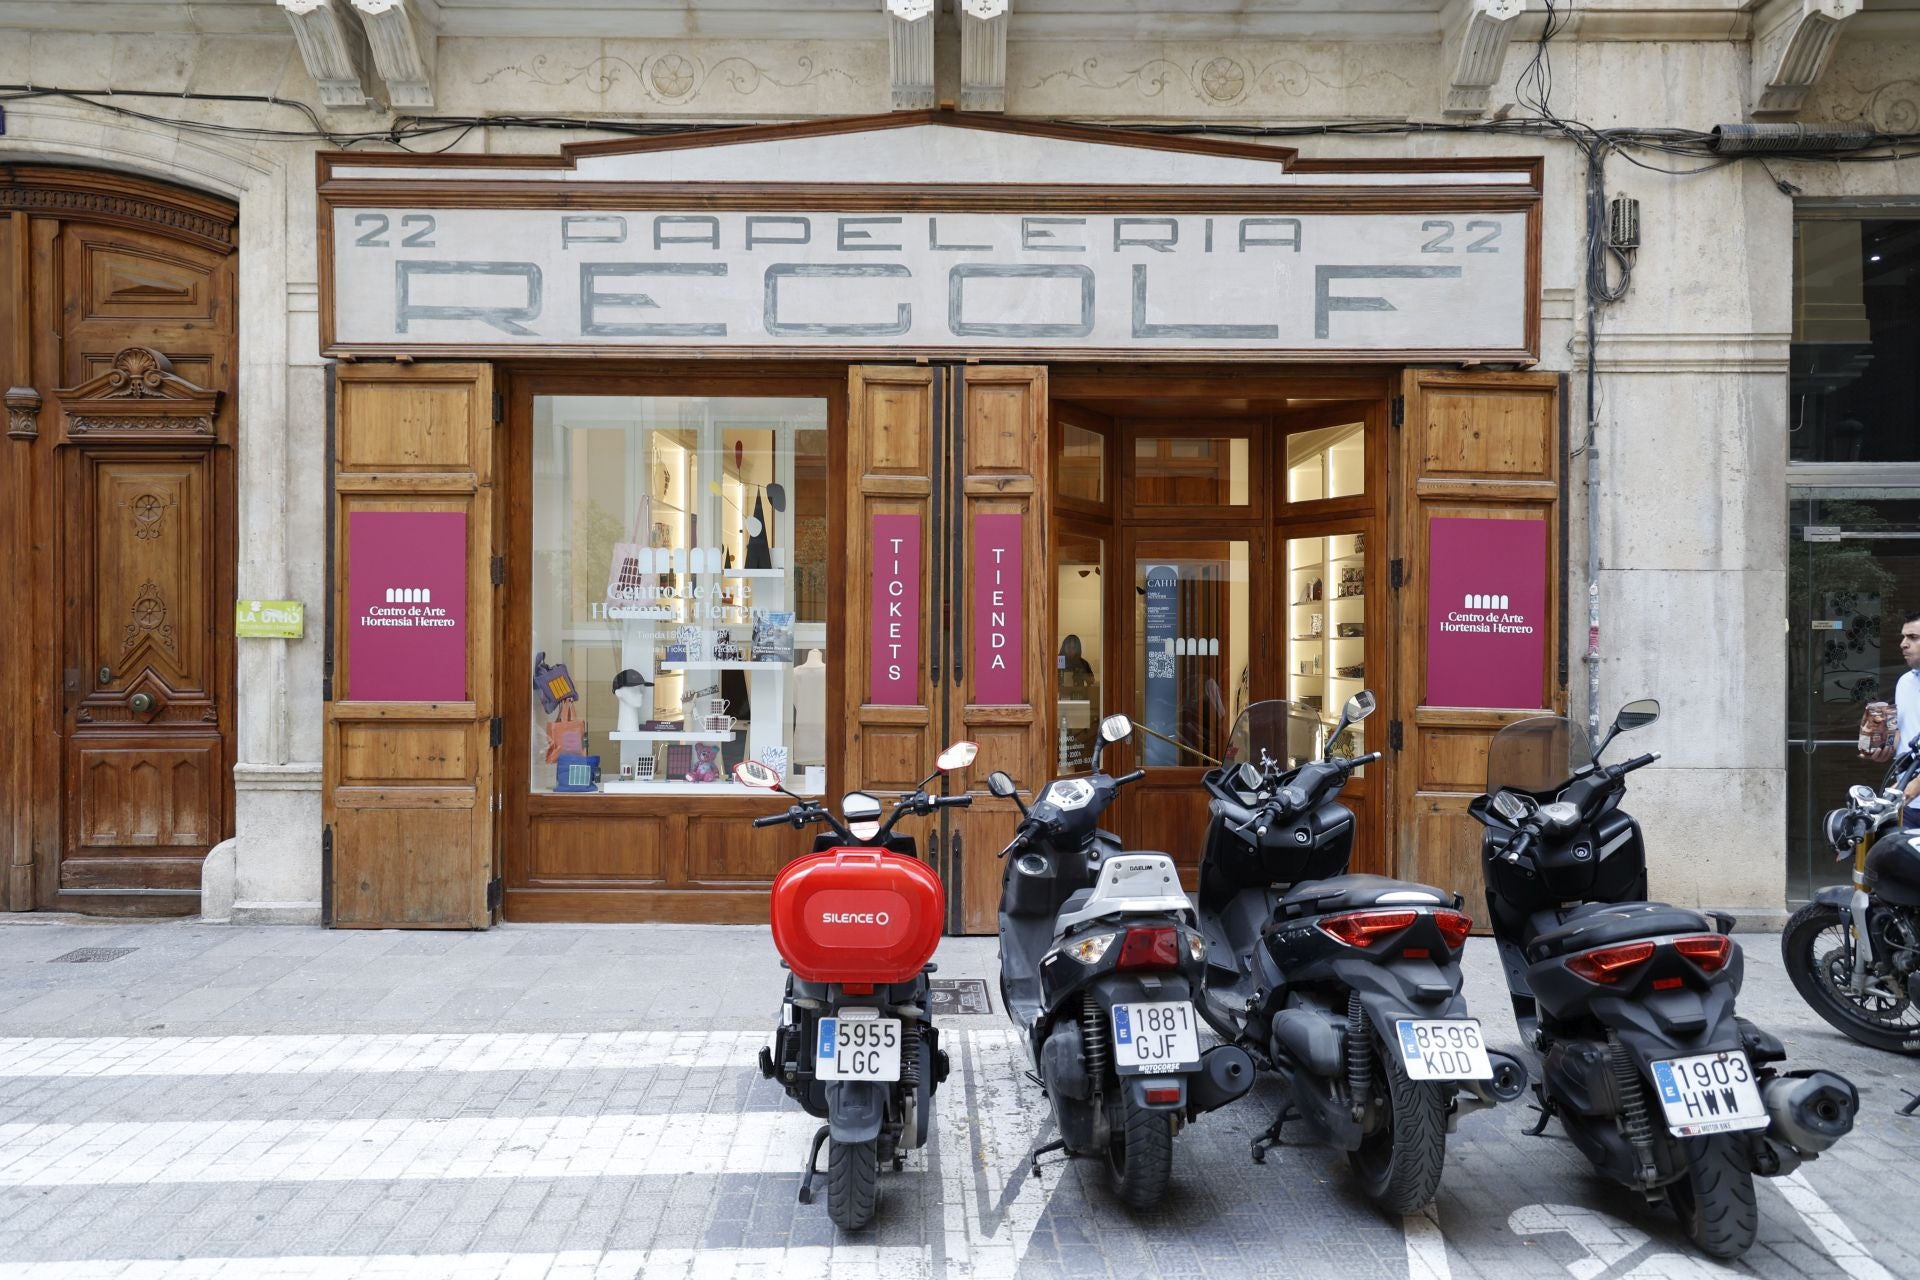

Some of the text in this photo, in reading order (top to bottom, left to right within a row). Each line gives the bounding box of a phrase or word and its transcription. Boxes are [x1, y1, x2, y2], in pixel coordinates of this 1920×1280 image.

[354, 213, 1500, 254] 22 PAPELERIA 22
[607, 581, 676, 600] Centro
[678, 581, 705, 599] de
[711, 582, 752, 600] Arte
[361, 616, 455, 627] Hortensia Herrero
[369, 606, 446, 616] Centro de Arte
[889, 539, 903, 680] TICKETS
[991, 549, 1005, 669] TIENDA
[1448, 611, 1524, 623] Centro de Arte
[1440, 622, 1533, 634] Hortensia Herrero
[822, 912, 874, 924] SILENCE
[1120, 1007, 1188, 1038] E 1881
[823, 1023, 896, 1052] E 5955
[1136, 1033, 1177, 1059] GJF
[1407, 1026, 1479, 1053] E 8596
[837, 1050, 880, 1074] LGC
[1138, 1063, 1180, 1071] MOTOCORSE
[1423, 1051, 1472, 1074] KDD
[1665, 1057, 1748, 1097] E 1903
[1682, 1087, 1739, 1118] HWW
